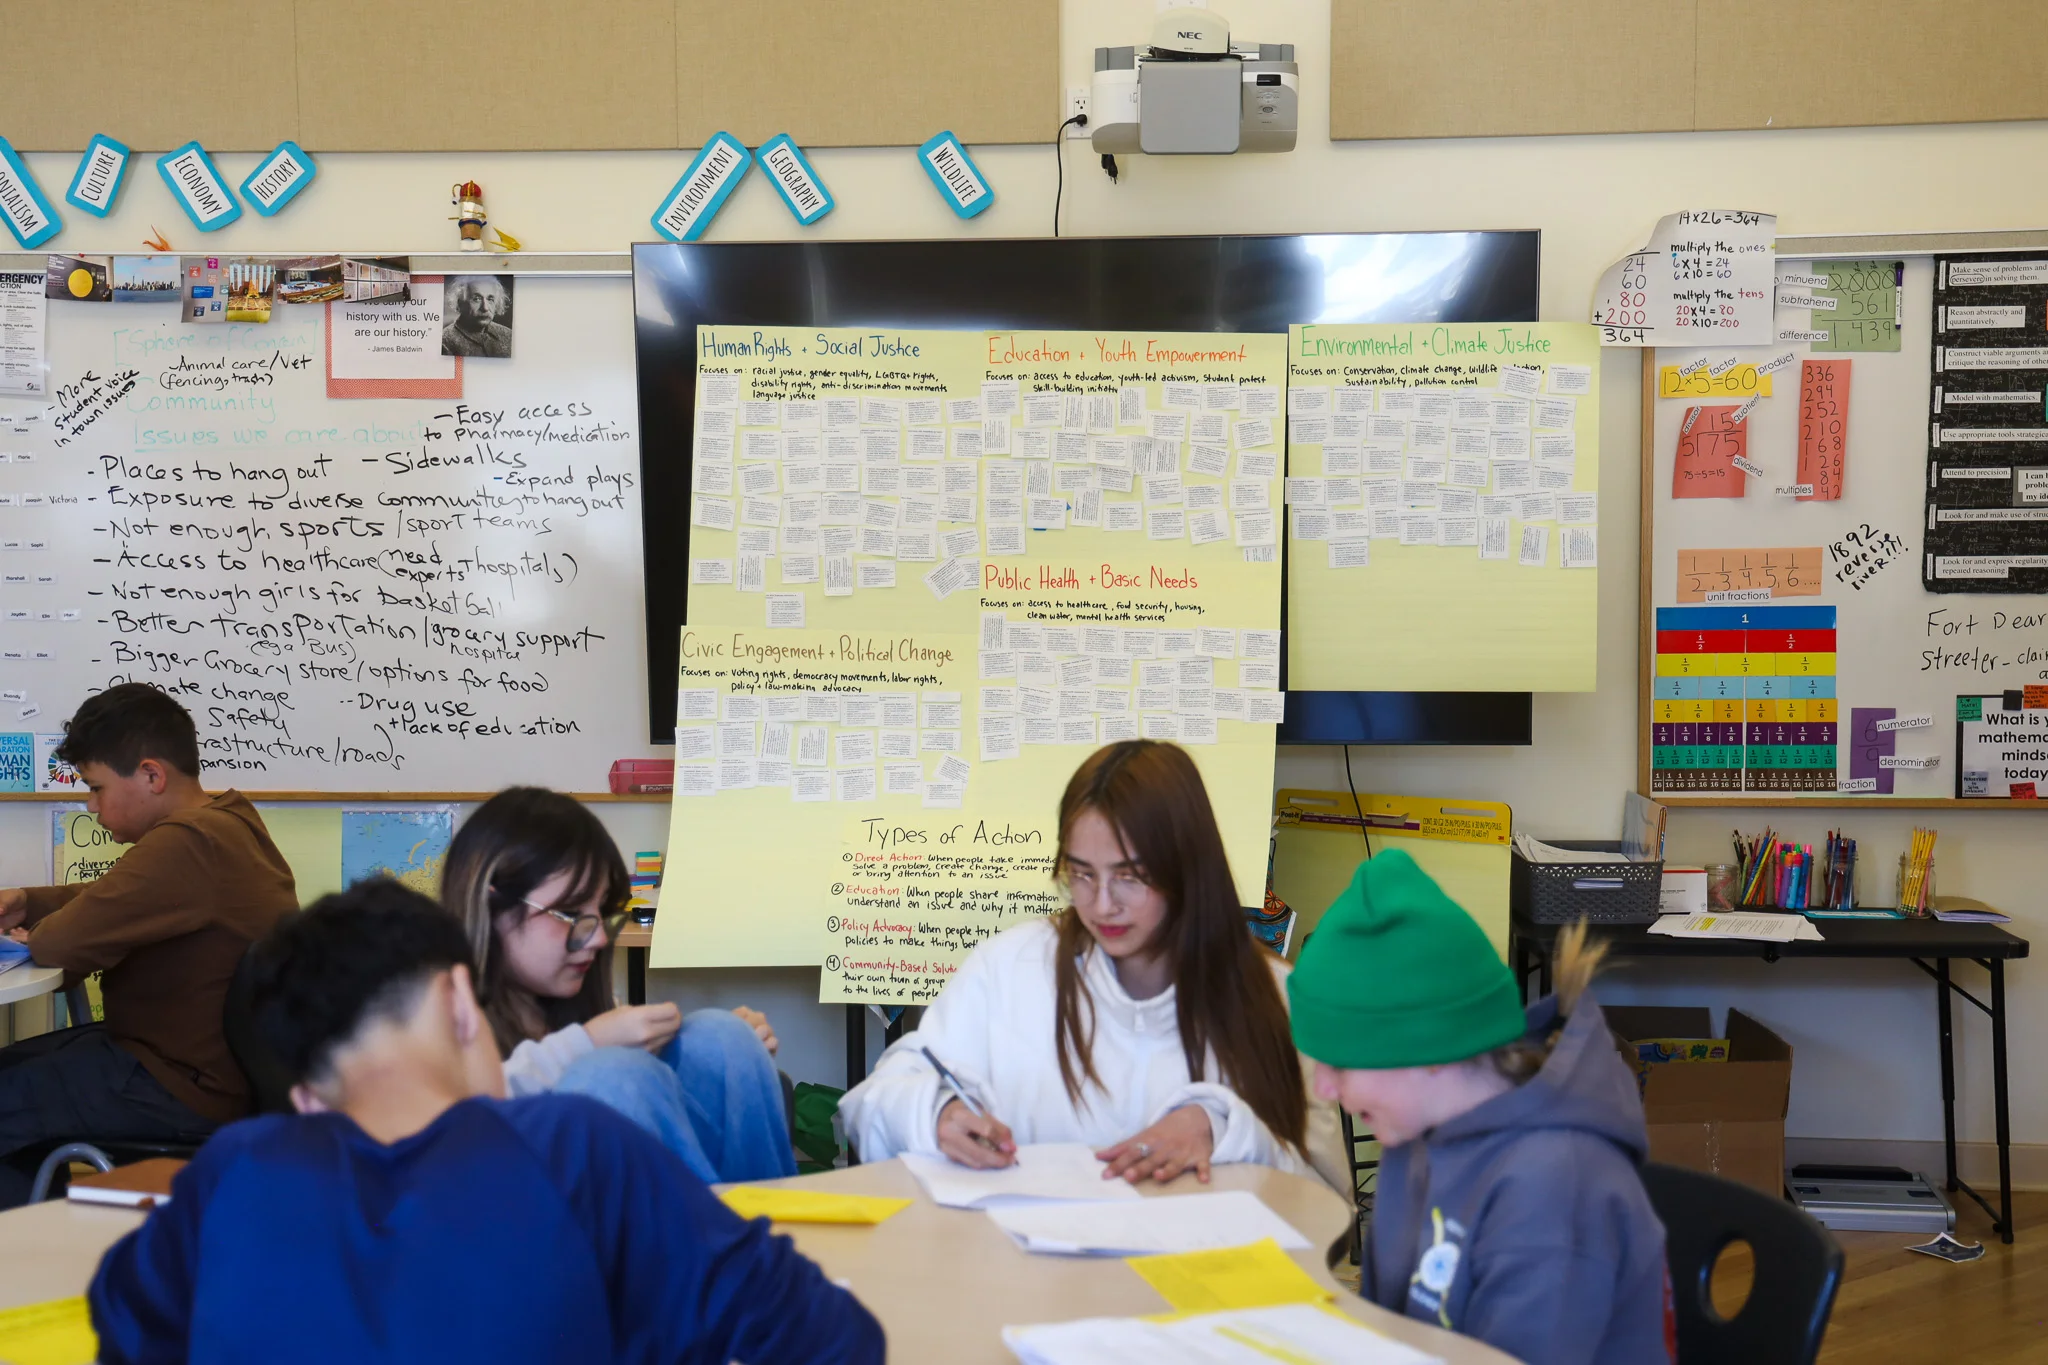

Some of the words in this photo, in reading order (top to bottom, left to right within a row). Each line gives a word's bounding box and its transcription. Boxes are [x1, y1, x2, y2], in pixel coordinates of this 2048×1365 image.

[81, 151, 116, 201] CULTURE
[254, 158, 297, 200] HISTORY
[770, 148, 820, 211] GEOGRAPHY
[933, 147, 976, 202] WILDLIFE
[174, 156, 222, 215] ECONOMY
[665, 147, 733, 232] ENVIRONMENT
[1671, 242, 1711, 255] multiply
[1714, 241, 1734, 253] the
[1739, 244, 1765, 253] ones
[1623, 256, 1645, 273] 24
[2002, 265, 2032, 273] problems
[1622, 274, 1646, 290] 60
[1785, 274, 1828, 285] minuend
[1620, 292, 1645, 307] 80
[1673, 290, 1711, 304] multiply
[1715, 289, 1734, 299] the
[1738, 288, 1764, 299] tens
[1781, 296, 1835, 307] subtrahend
[346, 311, 380, 324] history
[382, 312, 402, 321] with
[406, 313, 419, 322] us.
[424, 313, 440, 322] We
[1605, 311, 1645, 325] 200
[1977, 309, 2008, 317] abstractly
[1950, 318, 1997, 326] quantitatively.
[355, 329, 371, 337] are
[374, 329, 390, 337] our
[1301, 326, 1413, 356] Environmental
[1432, 327, 1488, 356] Climate
[1494, 329, 1550, 353] Justice
[1605, 329, 1645, 343] 364
[1780, 331, 1828, 341] difference
[702, 332, 750, 357] Human
[753, 332, 791, 362] Rights
[816, 333, 862, 357] Social
[869, 335, 920, 358] Justice
[989, 336, 1070, 364] Education
[1096, 338, 1136, 362] Youth
[1146, 340, 1247, 366] Empowerment
[179, 355, 225, 371] Animal
[1291, 365, 1322, 376] Focuses
[1434, 365, 1466, 376] change,
[1680, 357, 1708, 376] factor
[1709, 357, 1738, 376] factor
[1757, 353, 1794, 375] product
[105, 368, 140, 390] voice
[699, 365, 729, 374] Focuses
[753, 366, 776, 375] racial
[810, 369, 835, 379] gender
[840, 369, 871, 380] equality,
[1034, 372, 1058, 380] access
[1806, 366, 1834, 382] 336
[57, 371, 100, 408] More
[751, 379, 788, 390] disability
[905, 384, 947, 392] movements
[1414, 378, 1447, 386] pollution
[1451, 377, 1478, 385] control
[752, 390, 786, 401] language
[790, 391, 815, 401] justice
[1733, 393, 1760, 422] quotient
[72, 409, 103, 435] town
[457, 405, 505, 431] Easy
[518, 402, 592, 419] access
[1684, 407, 1700, 434] divisor
[234, 429, 268, 443] we
[385, 443, 527, 475] Sidewalks
[1734, 457, 1763, 477] dividend
[100, 455, 183, 481] Places
[193, 460, 221, 480] to
[229, 462, 290, 499] hang
[297, 453, 332, 478] out
[506, 465, 574, 493] Expand
[587, 465, 634, 492] plays
[1776, 485, 1812, 495] multiples
[50, 496, 77, 504] Victoria
[108, 486, 235, 512] Exposure
[249, 492, 273, 510] to
[288, 491, 363, 510] diverse
[543, 493, 588, 517] hang
[592, 494, 624, 510] out
[110, 517, 158, 538] Not
[474, 509, 552, 535] teams
[1829, 524, 1879, 563] 1892
[117, 550, 206, 571] Access
[218, 550, 247, 571] to
[985, 564, 1031, 590] Public
[1040, 566, 1080, 589] Health
[1101, 564, 1141, 589] Basic
[1150, 566, 1198, 589] Needs
[112, 581, 156, 599] Not
[161, 584, 250, 614] enough
[259, 582, 320, 612] girls
[327, 581, 361, 605] for
[1028, 600, 1051, 608] access
[1707, 593, 1725, 601] unit
[1727, 591, 1769, 600] fractions
[1105, 613, 1130, 621] health
[1134, 614, 1165, 622] services
[1927, 609, 1979, 636] Fort
[112, 610, 204, 633] Better
[517, 626, 605, 656] support
[681, 632, 724, 658] Civic
[732, 634, 825, 664] Engagement
[839, 635, 893, 663] Political
[898, 638, 954, 667] Change
[110, 641, 198, 672] Bigger
[204, 650, 292, 685] Grocery
[458, 669, 492, 694] for
[498, 672, 549, 693] food
[823, 684, 861, 693] advocacy
[212, 681, 294, 719] change
[358, 693, 416, 722] Drug
[424, 700, 476, 717] use
[209, 707, 291, 740] Safety
[1878, 716, 1931, 731] numerator
[1987, 713, 2024, 725] What
[2029, 713, 2039, 725] is
[1880, 757, 1940, 767] denominator
[1839, 780, 1874, 790] fraction
[862, 818, 927, 849] Types
[940, 825, 963, 844] of
[973, 820, 1042, 845] Action
[855, 853, 883, 862] Direct
[898, 869, 939, 878] attention
[847, 897, 900, 908] understand
[841, 919, 868, 936] Policy
[845, 936, 878, 947] policies
[843, 957, 927, 974] Community-Based
